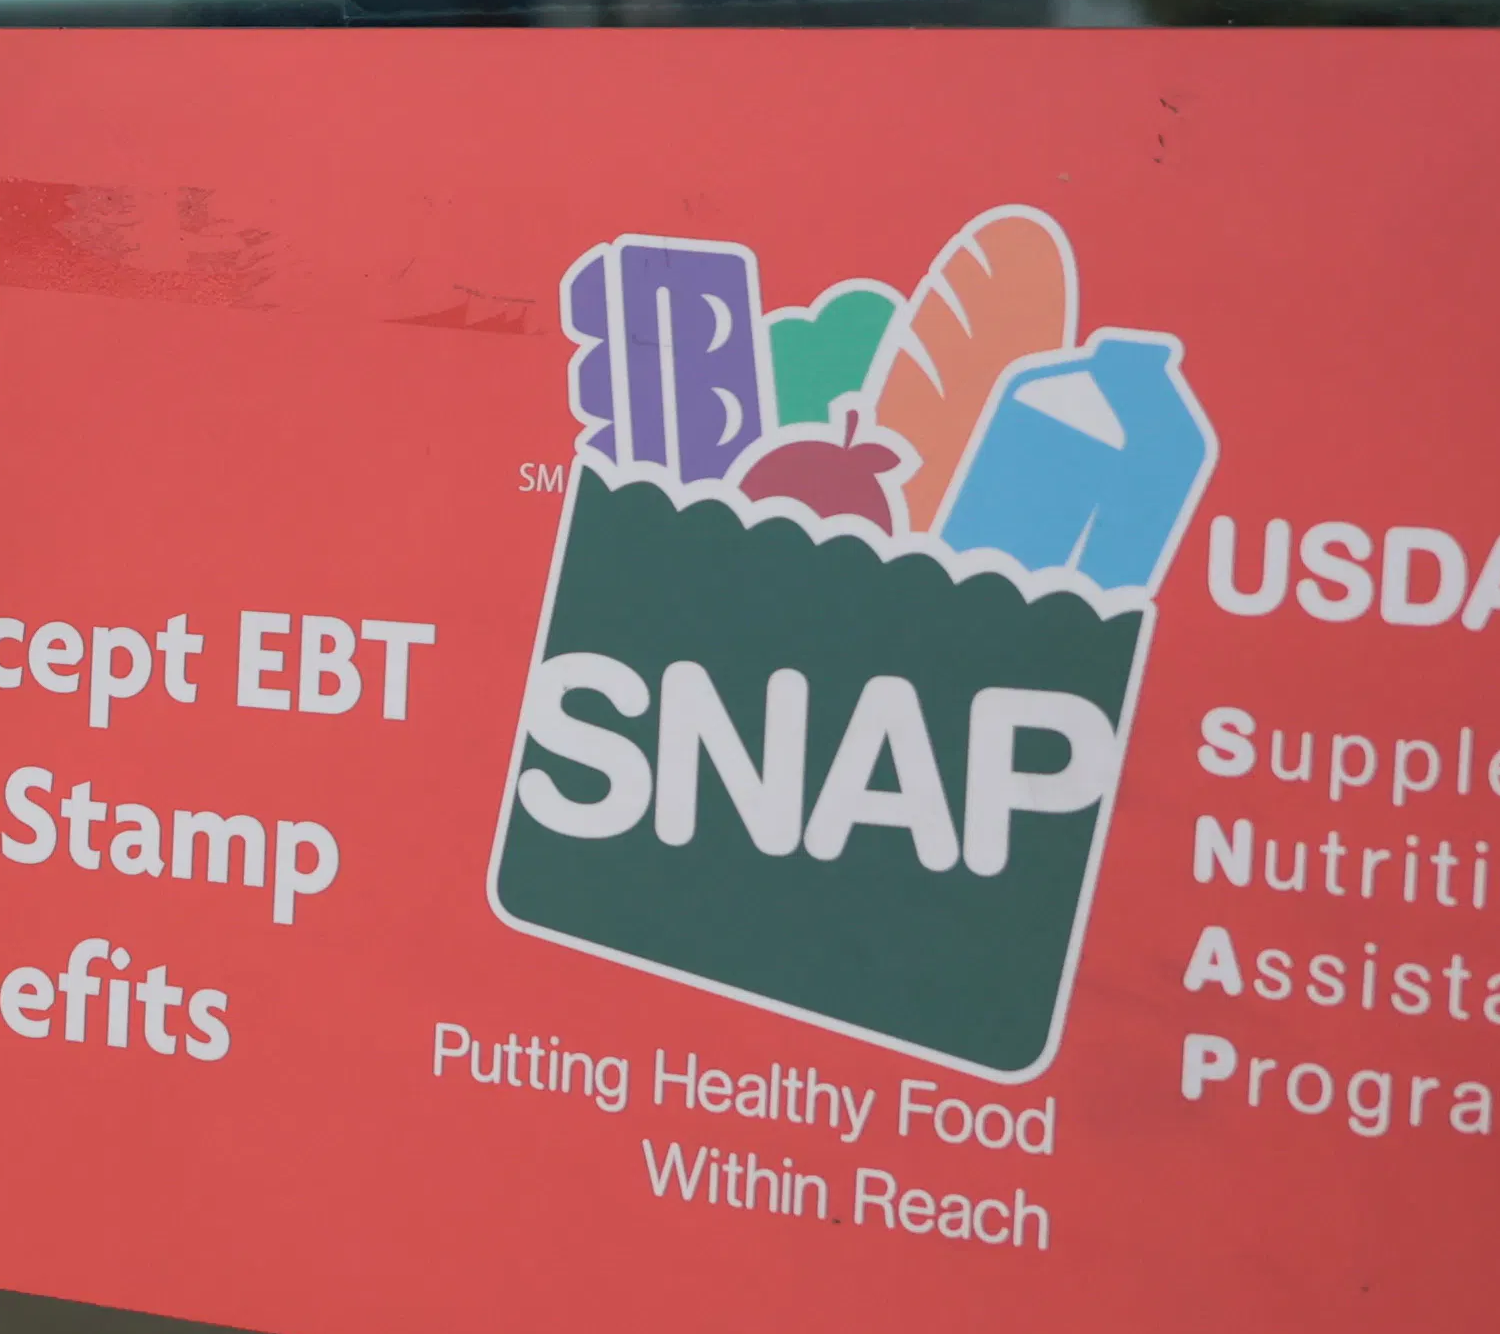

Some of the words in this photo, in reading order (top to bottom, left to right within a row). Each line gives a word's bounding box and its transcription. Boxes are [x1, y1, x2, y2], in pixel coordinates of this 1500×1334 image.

[519, 463, 564, 493] SM
[237, 611, 436, 721] EBT
[517, 650, 1117, 877] SNAP
[1, 767, 339, 925] Stamp
[432, 1022, 628, 1112] Putting
[654, 1049, 874, 1143] Healthy
[899, 1079, 1056, 1155] Food
[643, 1139, 827, 1220] Within
[853, 1169, 1050, 1250] Reach
